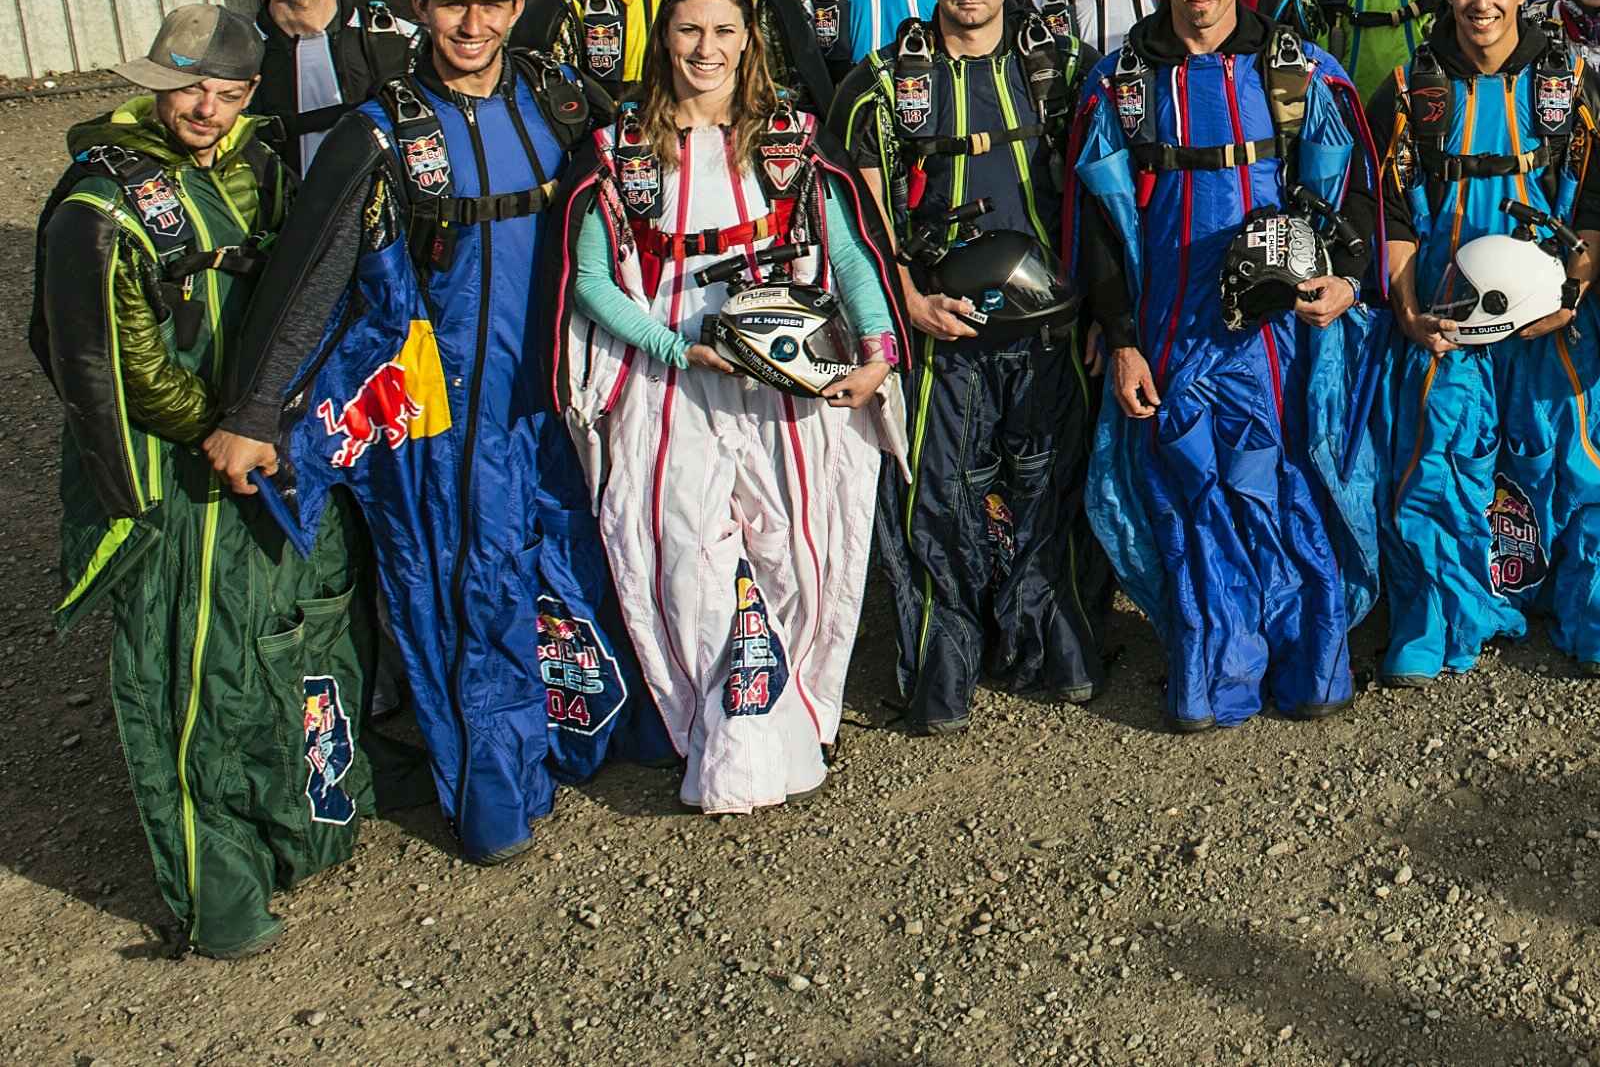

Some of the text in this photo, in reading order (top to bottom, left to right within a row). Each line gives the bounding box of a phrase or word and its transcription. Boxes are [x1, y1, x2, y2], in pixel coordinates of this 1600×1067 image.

[902, 109, 922, 124] 18
[1543, 108, 1565, 123] 30
[760, 142, 801, 158] velocity
[419, 168, 446, 188] 04
[628, 190, 652, 205] 54
[765, 317, 804, 327] HANSEN
[1479, 324, 1513, 334] DUCLOS
[1500, 515, 1537, 544] Bull
[540, 660, 604, 694] CES
[546, 688, 591, 727] 04
